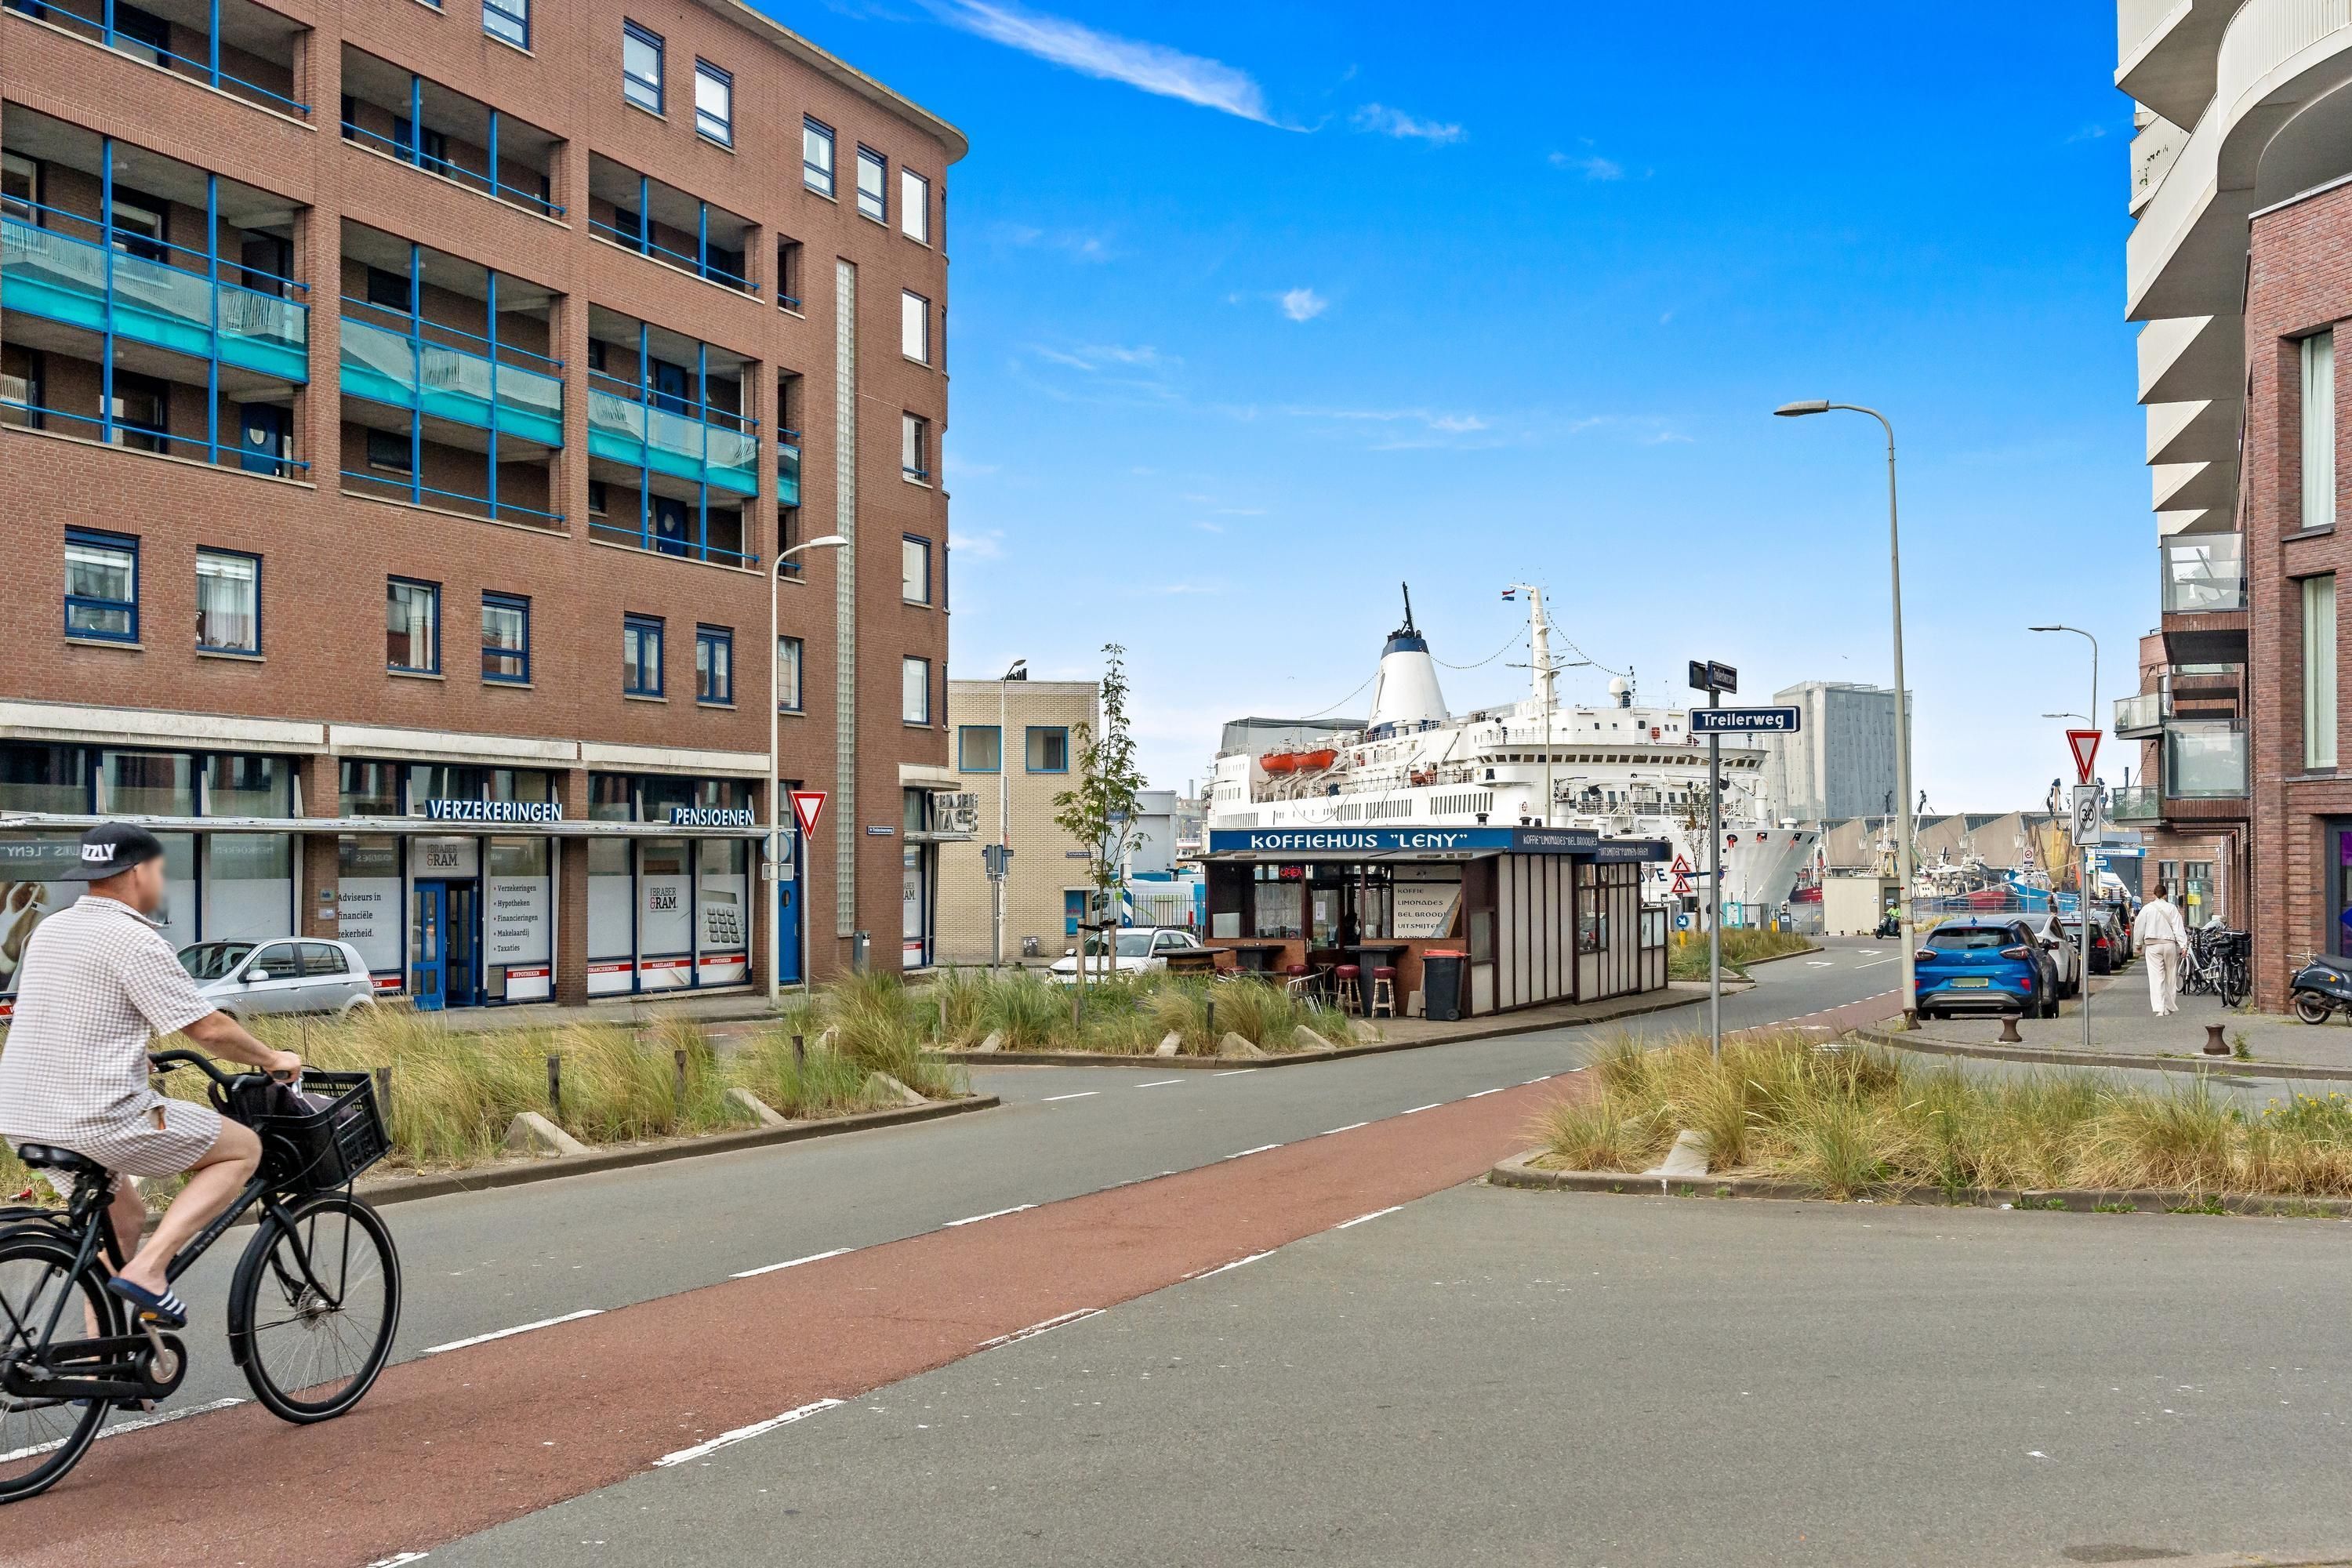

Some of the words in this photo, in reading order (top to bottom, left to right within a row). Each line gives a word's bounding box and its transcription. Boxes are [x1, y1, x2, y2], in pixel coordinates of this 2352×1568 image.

[1702, 713, 1784, 729] Treilerweg
[431, 800, 562, 821] VERZEKERINGEN
[2082, 808, 2094, 822] 30
[677, 808, 754, 826] PENSIOENEN
[1250, 834, 1378, 848] KOFFIEHUIS
[1390, 833, 1468, 848] "LENY"
[1279, 867, 1302, 877] OPEN
[497, 884, 537, 893] Verzekeringen
[652, 887, 677, 896] BRABER
[338, 892, 372, 902] Adviseurs
[374, 891, 381, 902] in
[497, 898, 530, 909] Hypotheken
[338, 910, 373, 920] financiële
[497, 914, 539, 923] Financieringen
[338, 928, 374, 938] zekerheid.
[497, 928, 530, 938] Makelaardij
[497, 943, 521, 953] Taxaties
